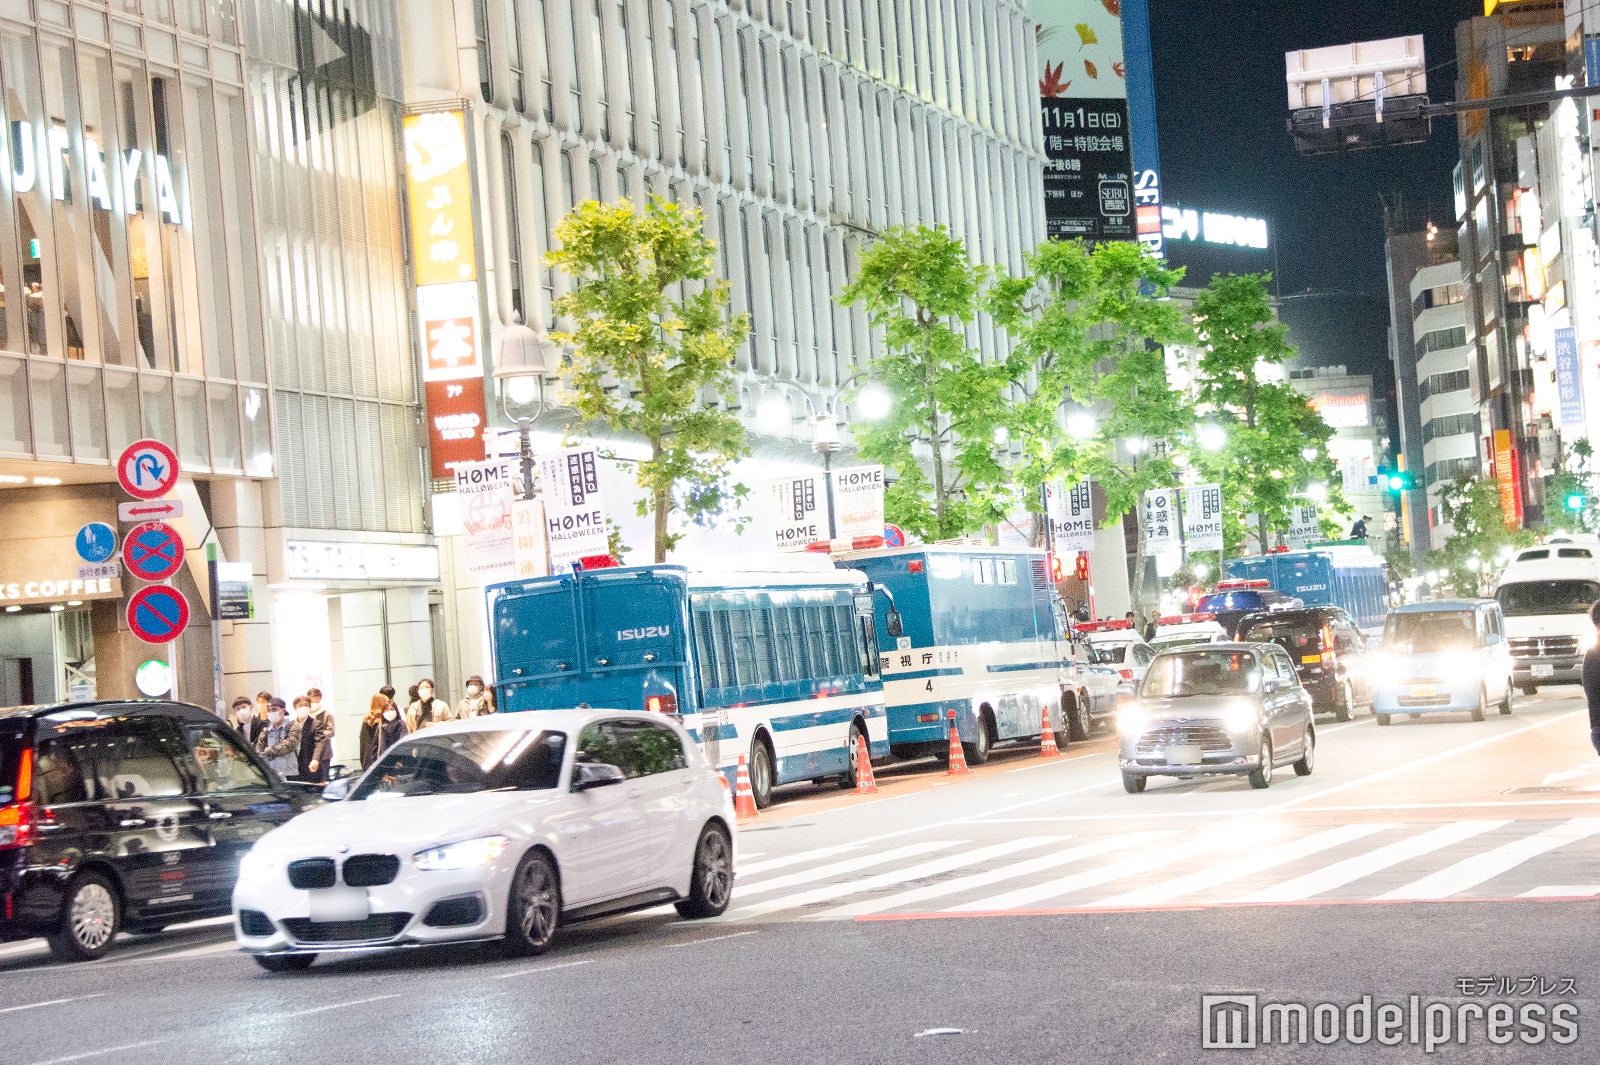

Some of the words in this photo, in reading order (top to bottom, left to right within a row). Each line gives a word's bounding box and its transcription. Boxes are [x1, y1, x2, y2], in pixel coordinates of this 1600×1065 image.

[1101, 188, 1127, 200] SEIBU
[429, 320, 473, 366] 本
[79, 566, 116, 577] 歩行者優先
[24, 578, 112, 598] COFFEE
[1296, 584, 1326, 593] ISUZU
[617, 625, 670, 641] ISUZU
[881, 653, 933, 669] 警視庁
[925, 679, 933, 693] 4
